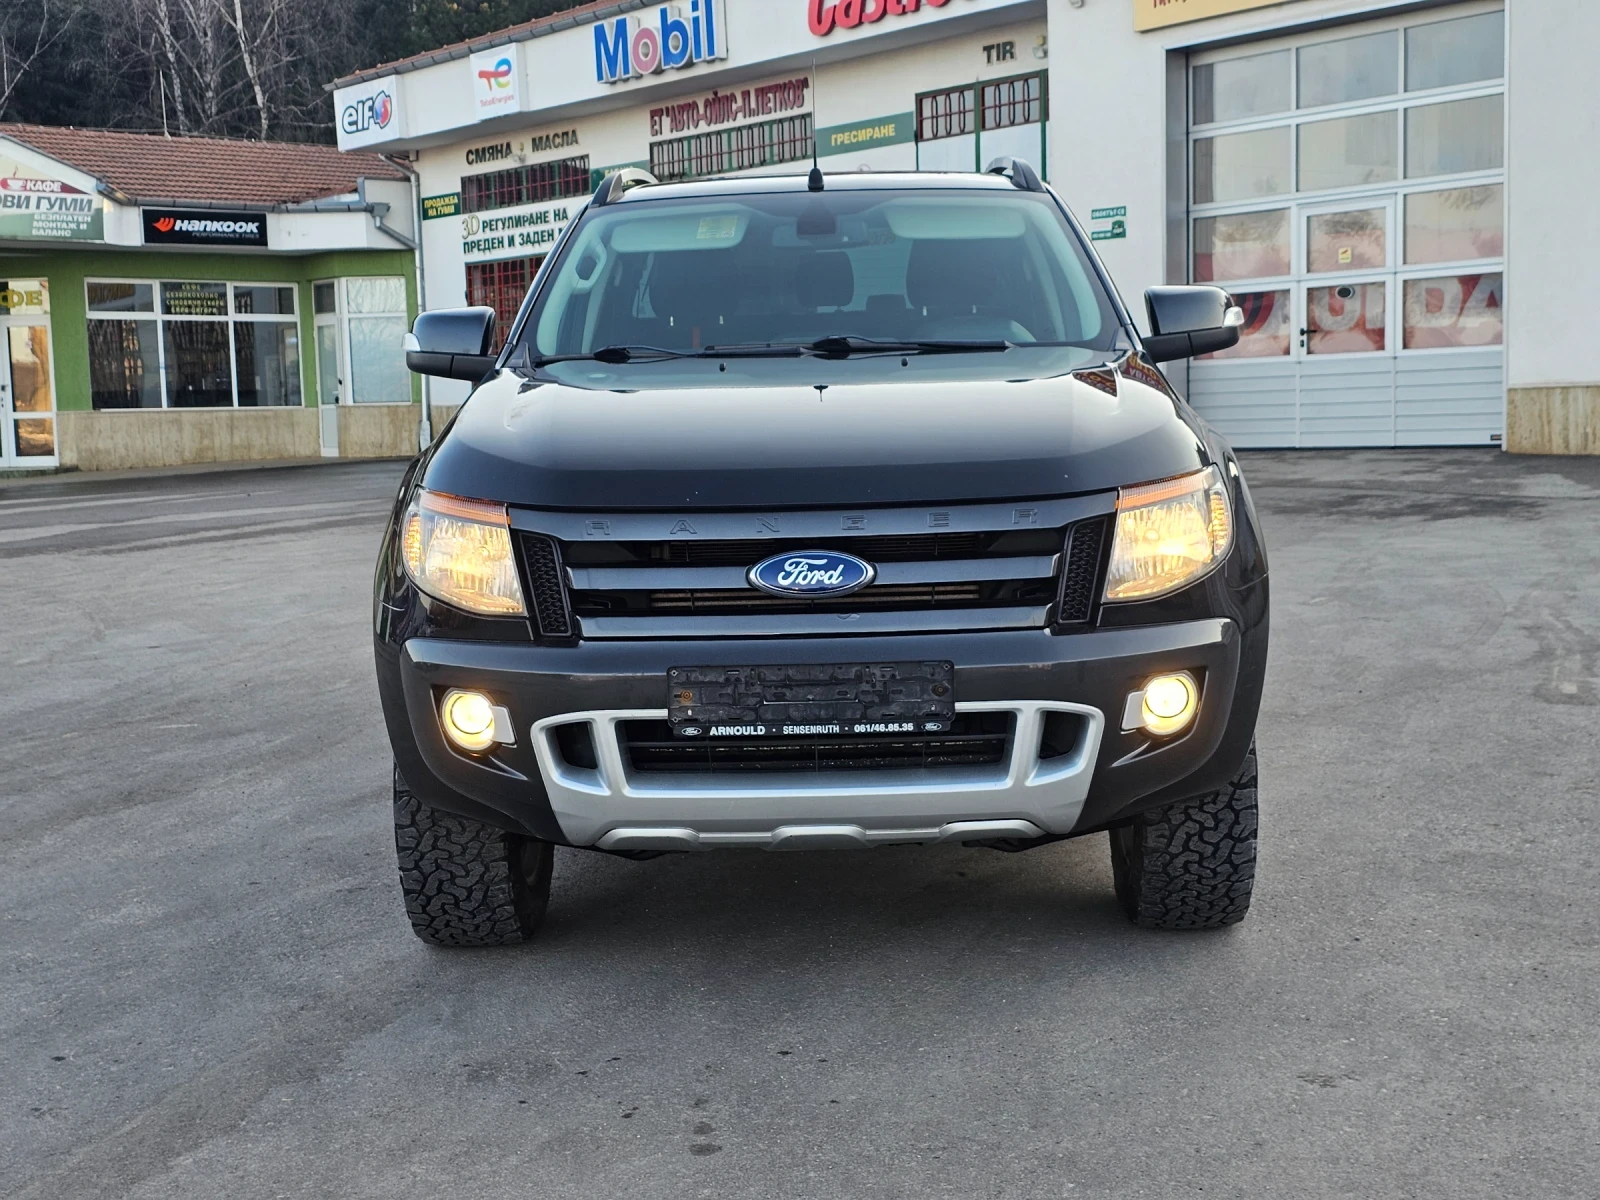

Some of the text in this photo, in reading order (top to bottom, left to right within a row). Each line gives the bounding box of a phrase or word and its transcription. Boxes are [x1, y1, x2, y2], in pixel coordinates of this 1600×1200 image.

[593, 0, 716, 83] Mobil
[982, 40, 1015, 65] TIR
[342, 96, 374, 134] elf
[831, 123, 896, 146] ГРЕСИРАНЕ
[466, 129, 579, 165] СМЯНА МАСЛА
[27, 180, 63, 192] КАФЕ
[0, 194, 93, 213] ВИ ГУМИ
[424, 194, 459, 208] ПРОДАЖБА
[428, 204, 455, 217] НА ГУМИ
[33, 221, 87, 231] МОНТАЖ И
[34, 213, 92, 222] БЕЗПЛАТЕН
[482, 210, 550, 233] РЕГУЛИРАНЕ
[553, 207, 569, 223] НА
[32, 228, 72, 237] БАЛАНС
[463, 235, 505, 255] ПРЕДЕН
[507, 234, 515, 248] И
[518, 228, 555, 248] ЗАДЕН
[585, 508, 1038, 536] RANGER
[777, 558, 844, 585] Ford
[709, 725, 766, 736] ARNOULD
[782, 724, 840, 735] SENSENRUTH
[854, 723, 914, 733] 061/46.85.35
